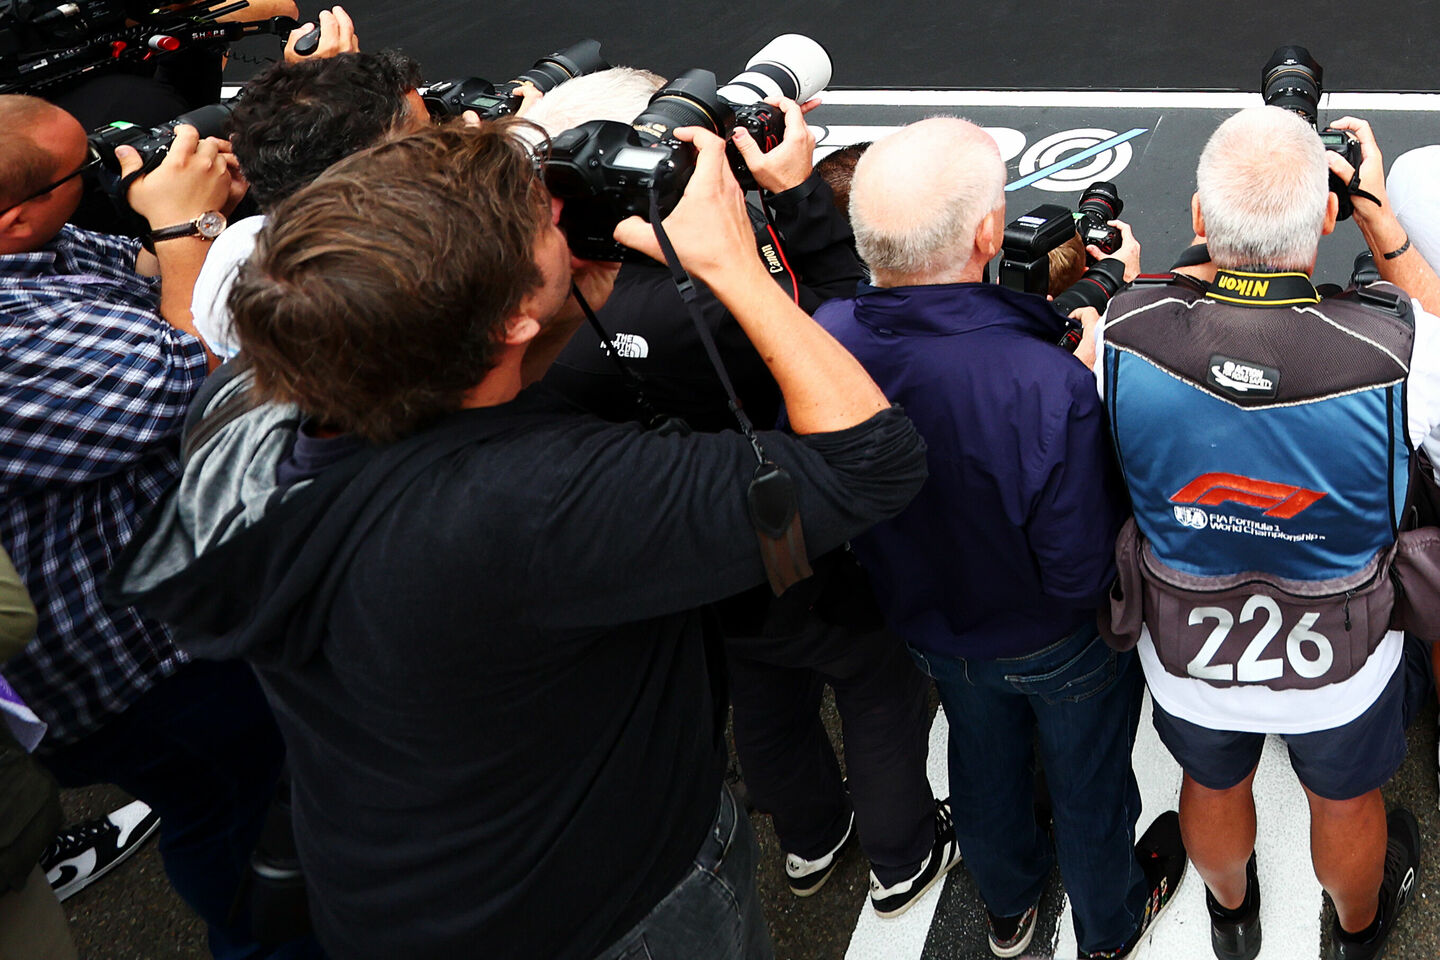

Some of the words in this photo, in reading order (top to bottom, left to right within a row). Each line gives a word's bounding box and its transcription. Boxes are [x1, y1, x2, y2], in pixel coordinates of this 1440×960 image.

[191, 28, 226, 39] SHAPE
[761, 243, 784, 274] Canon
[1218, 275, 1270, 298] Nikon
[615, 332, 634, 342] THE
[1209, 513, 1228, 524] FIA
[1229, 515, 1274, 532] Formula
[1209, 521, 1243, 533] World
[1187, 594, 1334, 682] 226
